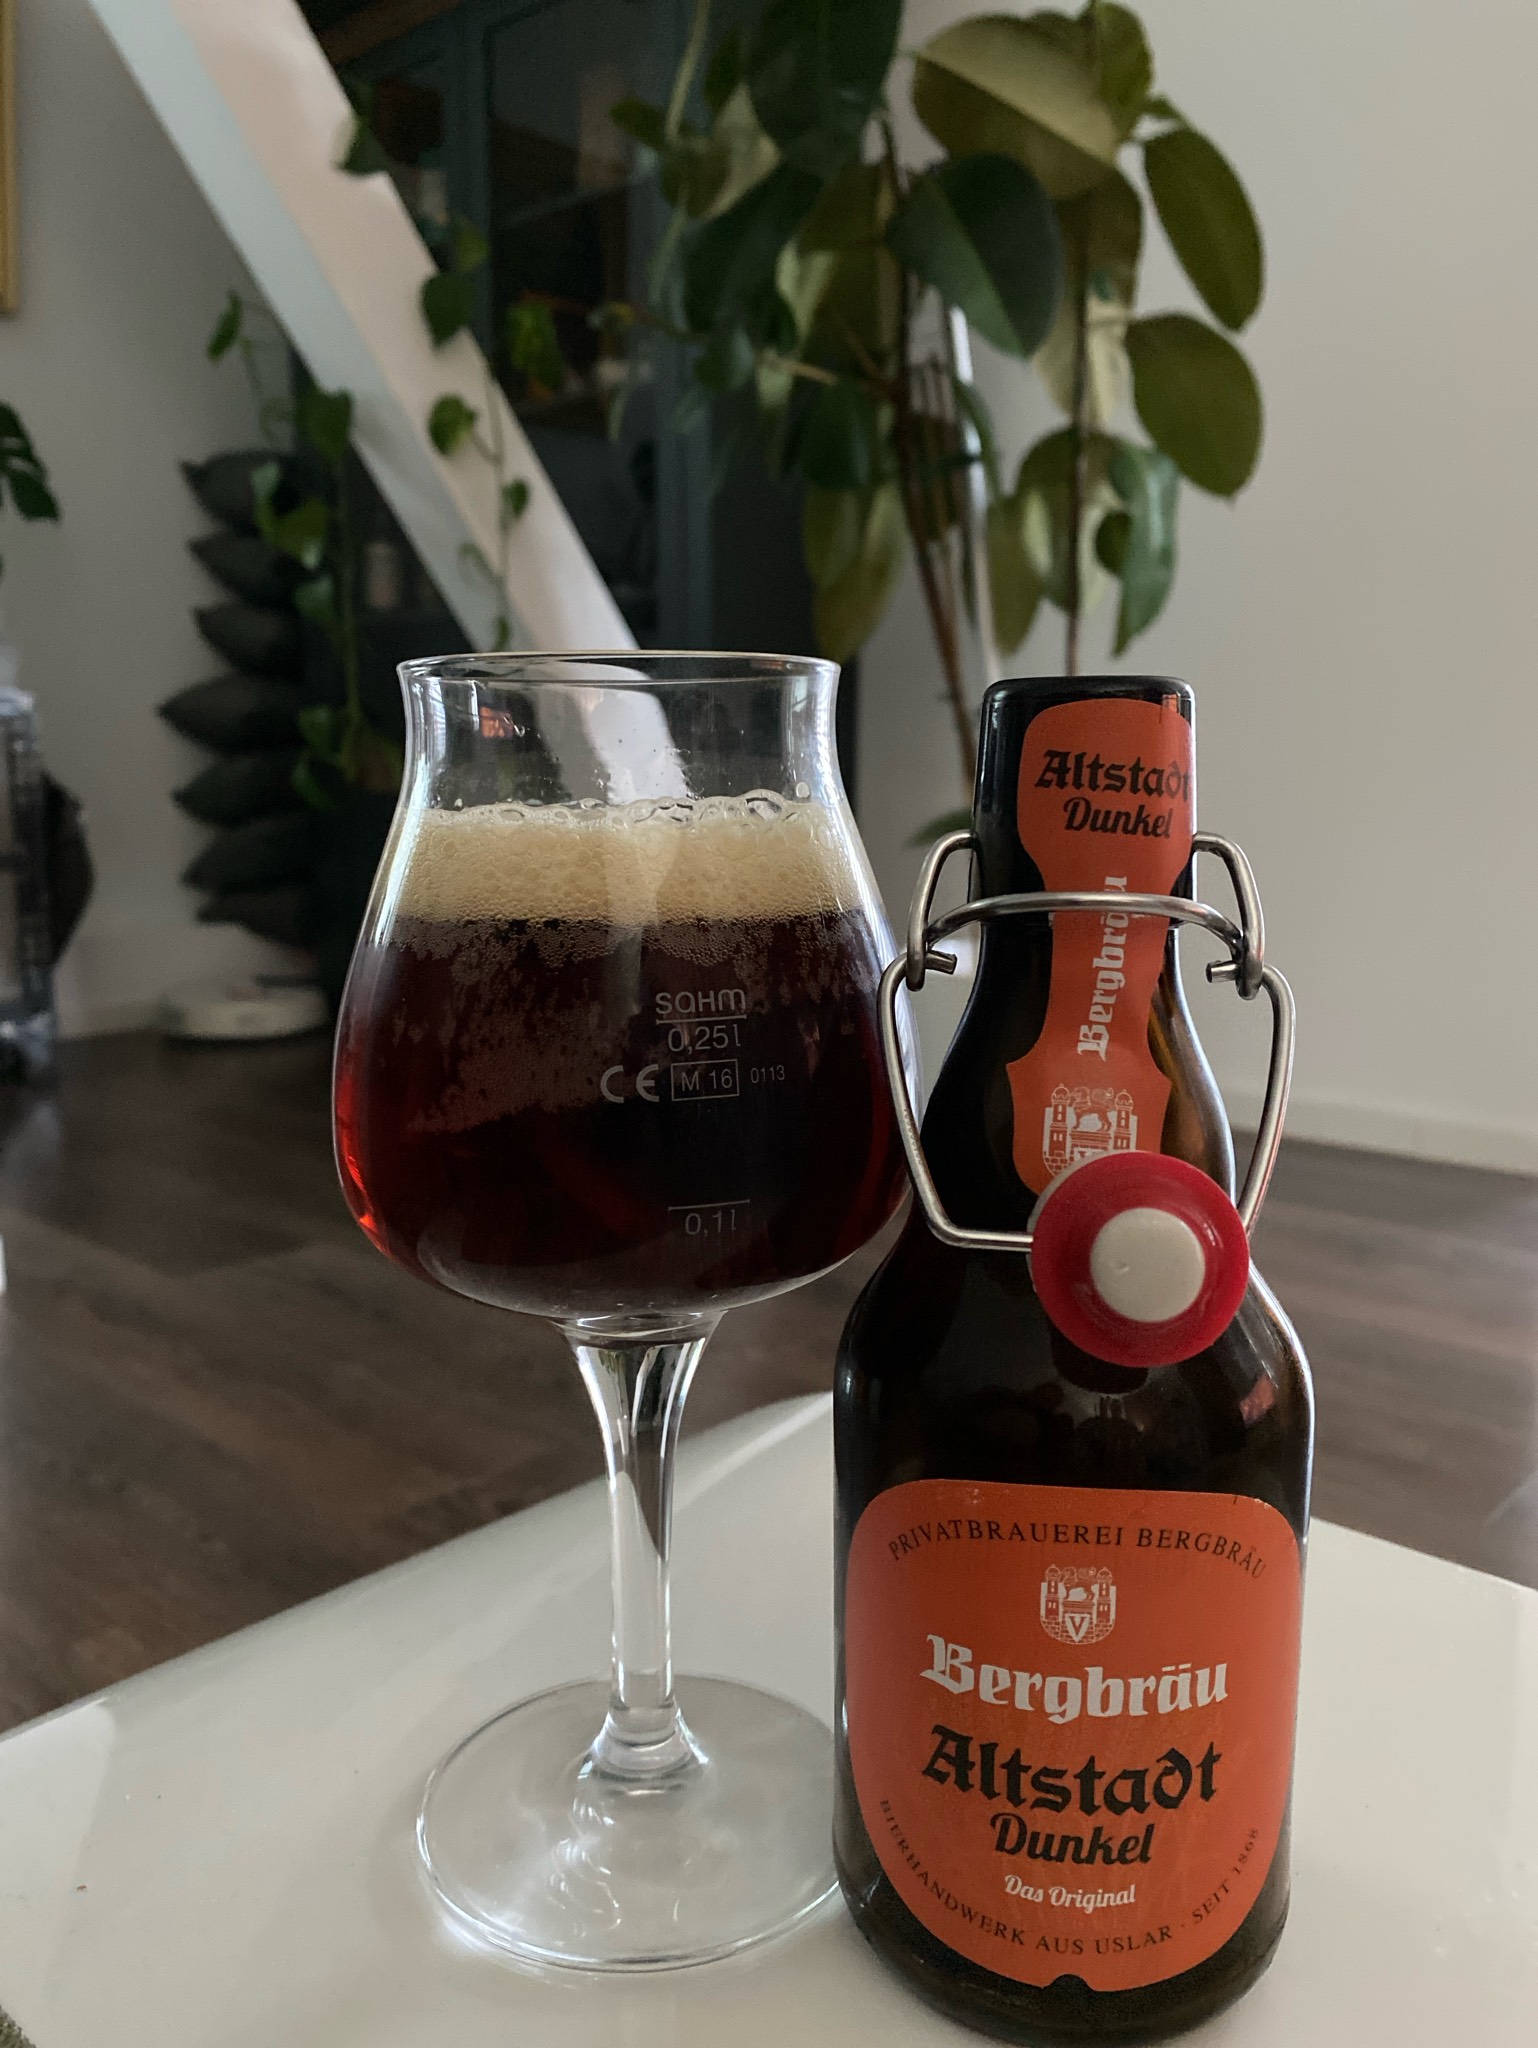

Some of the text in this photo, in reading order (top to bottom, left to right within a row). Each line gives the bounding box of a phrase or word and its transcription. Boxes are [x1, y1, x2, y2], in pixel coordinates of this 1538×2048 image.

[1034, 749, 1189, 802] Altstadt
[1063, 796, 1173, 839] Dunkel
[600, 1063, 786, 1104] CE M 16 0113
[886, 1519, 1267, 1580] PRIVATBRAUEREI BERGBRÄU
[919, 1633, 1229, 1725] Bergbräu
[921, 1724, 1223, 1816] Altstadt
[990, 1812, 1155, 1866] Dunkel
[880, 1799, 1025, 1946] BIERHANDWERK
[1035, 1934, 1085, 1956] AUS
[1094, 1925, 1173, 1955] USLAR
[1190, 1878, 1231, 1924] SEIT
[1004, 1874, 1136, 1915] Das Original
